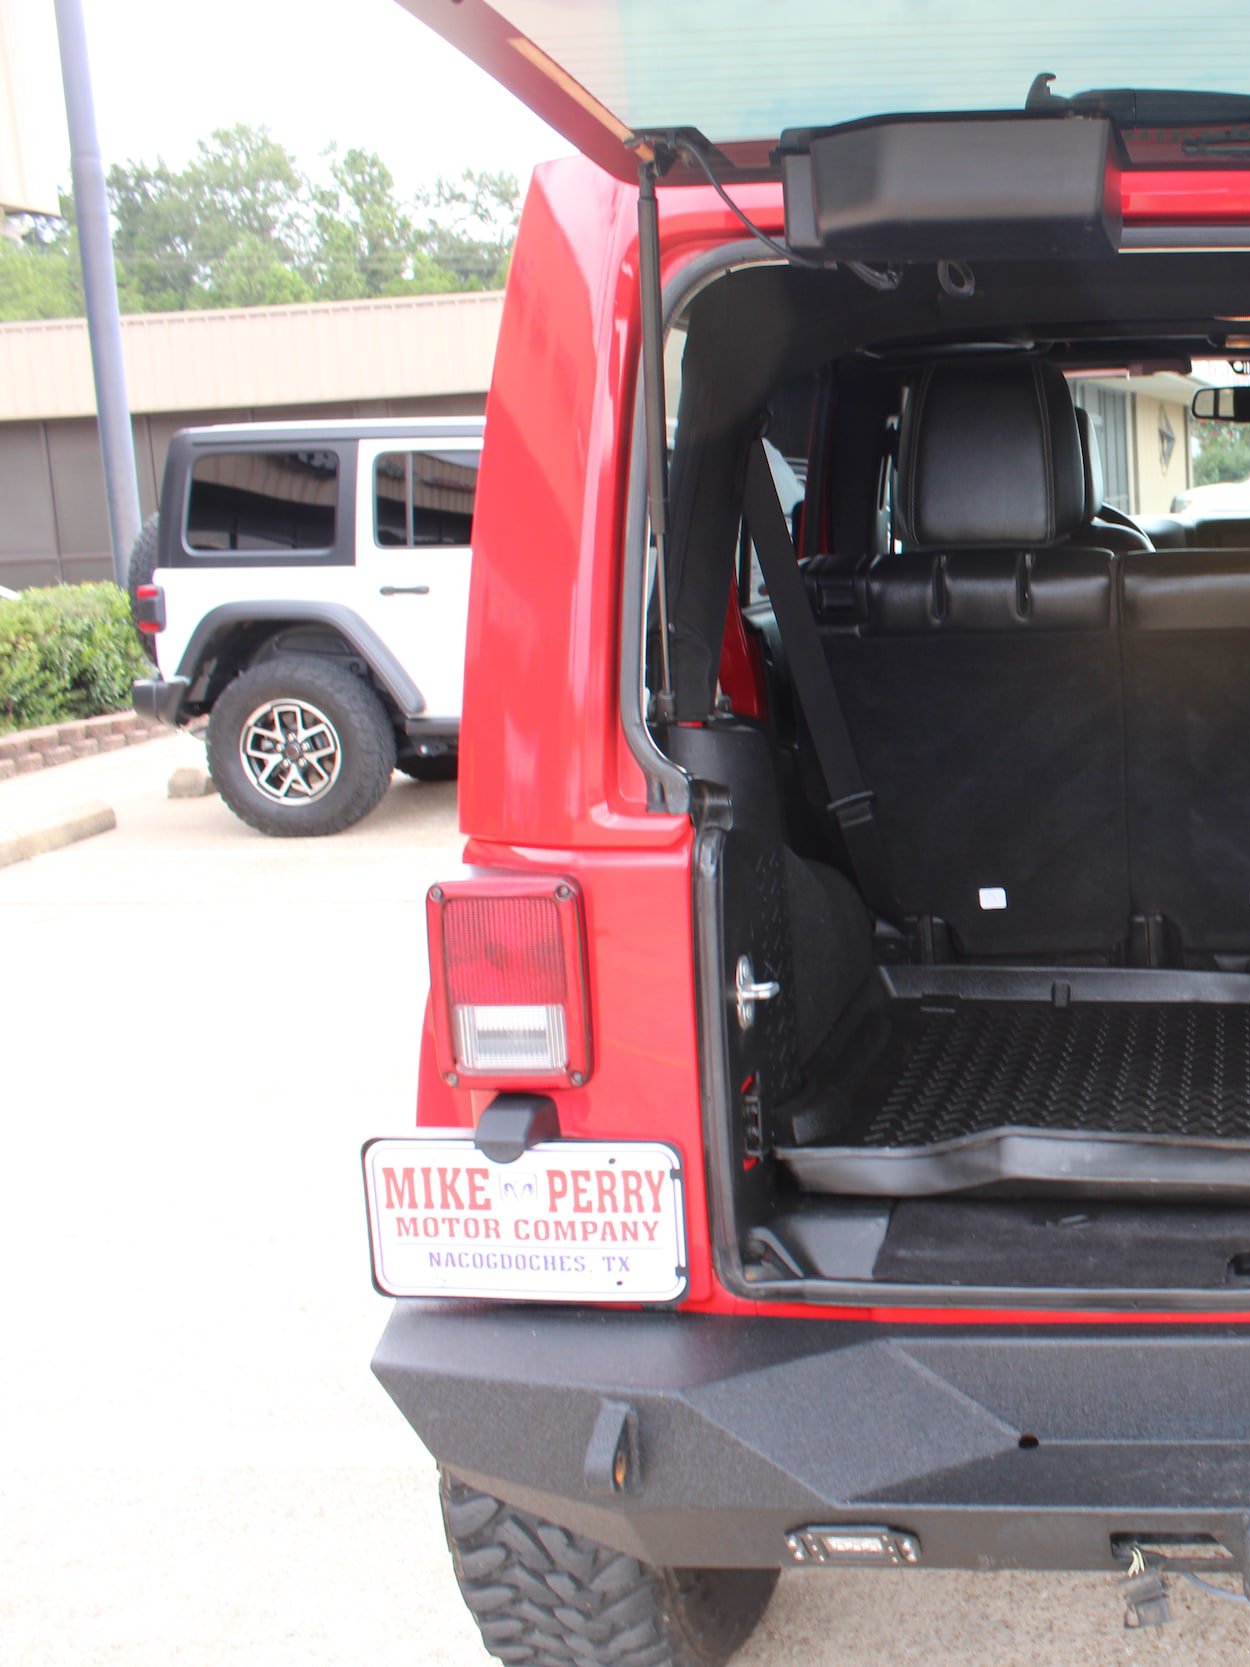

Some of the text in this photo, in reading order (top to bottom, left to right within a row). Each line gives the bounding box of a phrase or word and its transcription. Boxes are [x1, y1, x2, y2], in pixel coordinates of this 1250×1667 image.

[382, 1167, 666, 1213] MIKE PERRY
[395, 1216, 659, 1242] MOTOR COMPANY
[602, 1256, 631, 1272] TX
